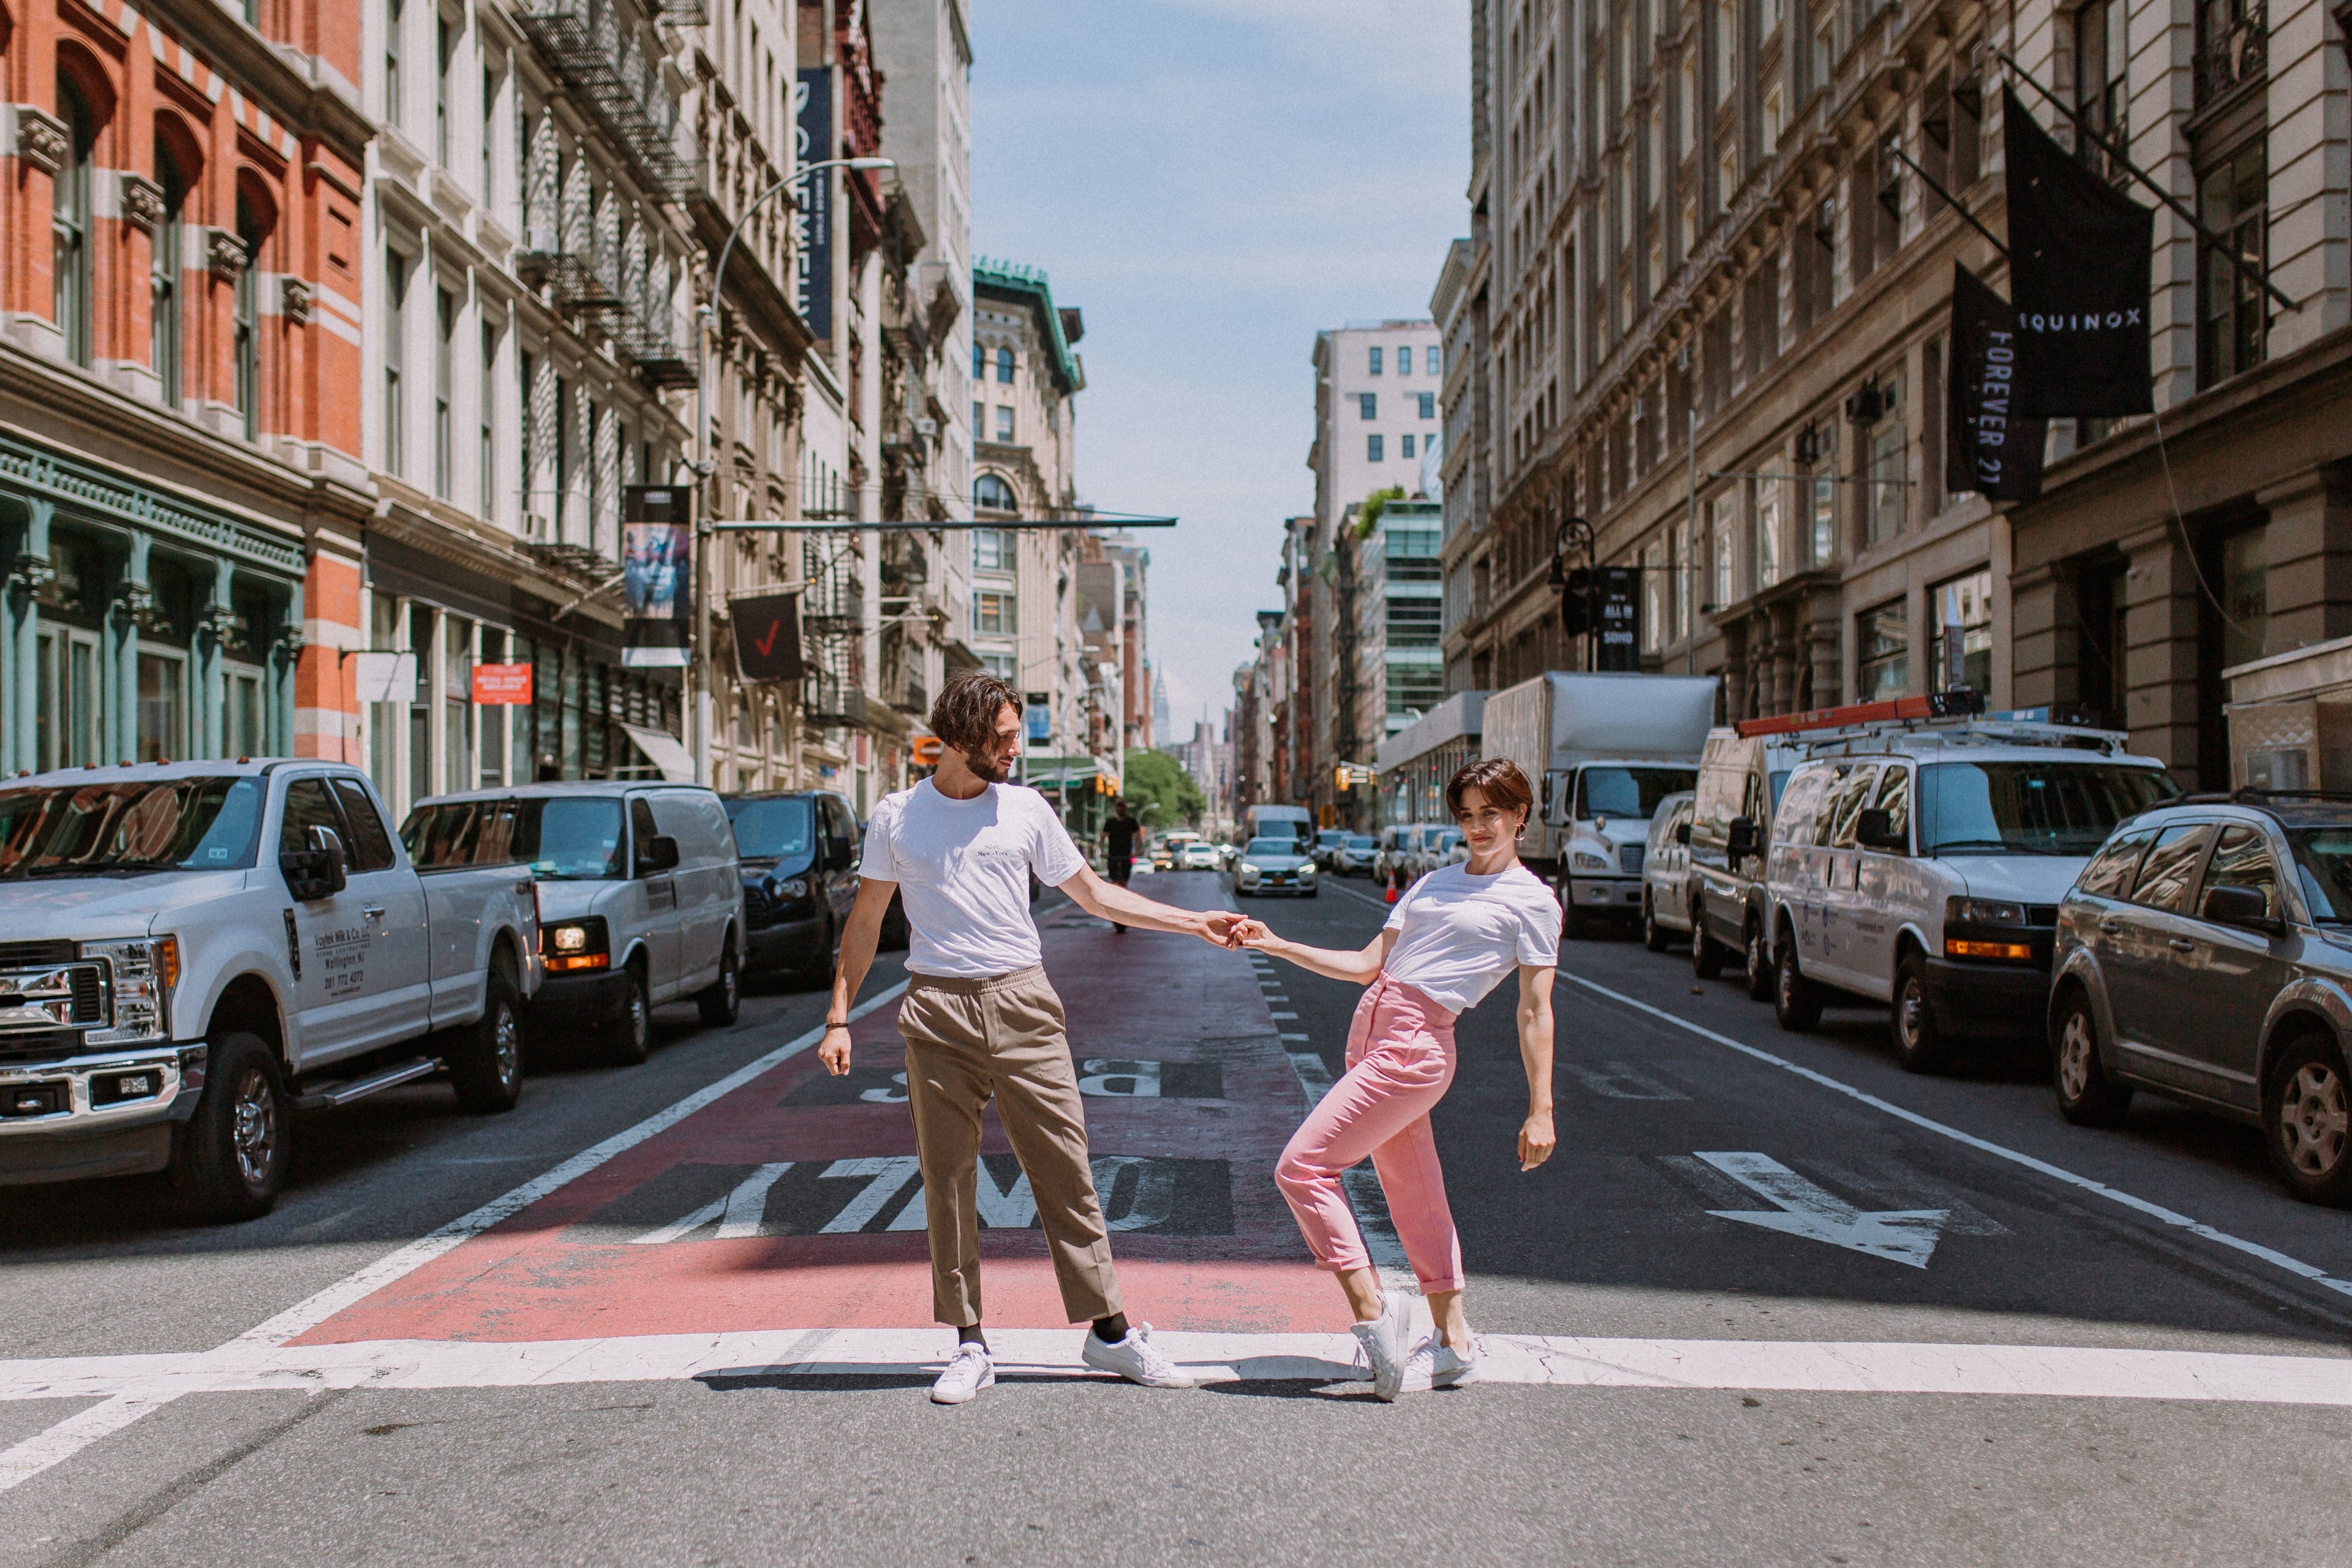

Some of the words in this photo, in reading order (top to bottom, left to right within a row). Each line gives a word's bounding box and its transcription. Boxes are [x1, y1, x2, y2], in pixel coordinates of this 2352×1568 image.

[2020, 307, 2141, 333] EQUINOX
[1978, 331, 2014, 447] FOREVER
[1978, 458, 2002, 484] 21
[1603, 631, 1633, 644] SOHO
[630, 1155, 1175, 1245] ONLY
